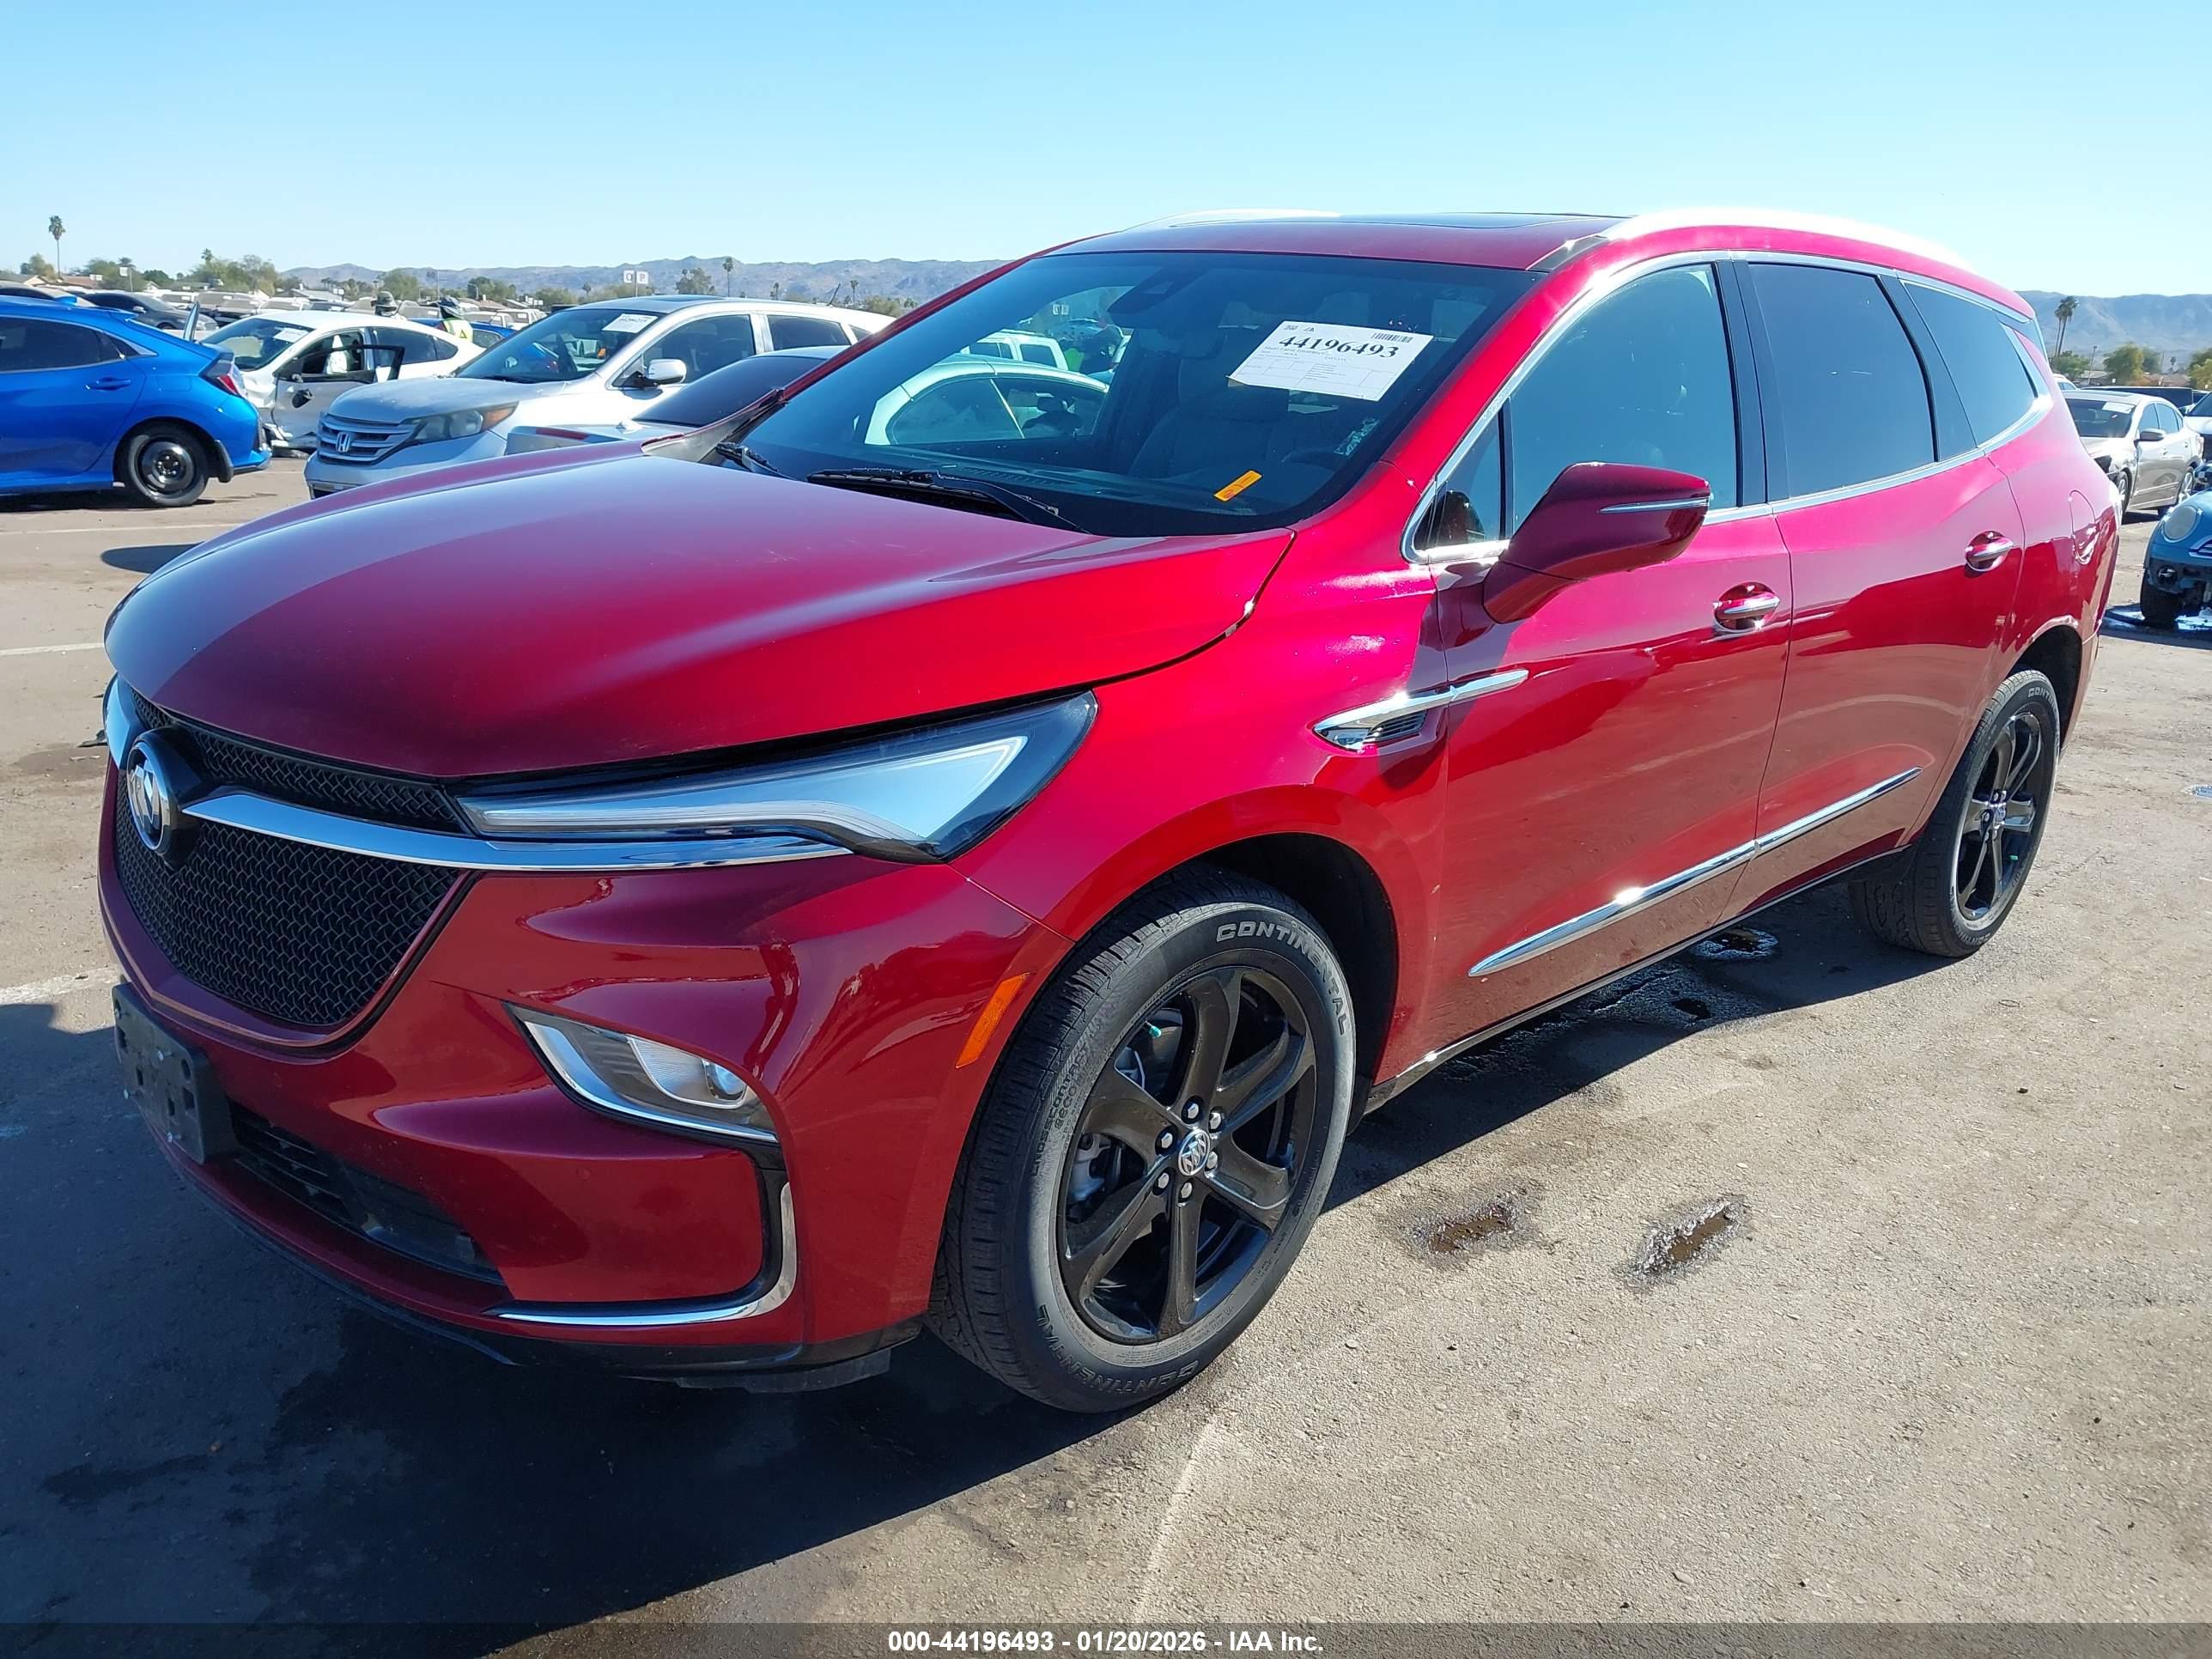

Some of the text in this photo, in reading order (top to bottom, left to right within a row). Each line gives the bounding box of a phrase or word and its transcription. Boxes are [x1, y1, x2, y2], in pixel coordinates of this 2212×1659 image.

[1279, 336, 1400, 358] 44196493
[1216, 921, 1348, 1036] CONTINENTAL
[1036, 1304, 1200, 1394] CONTINENTAL
